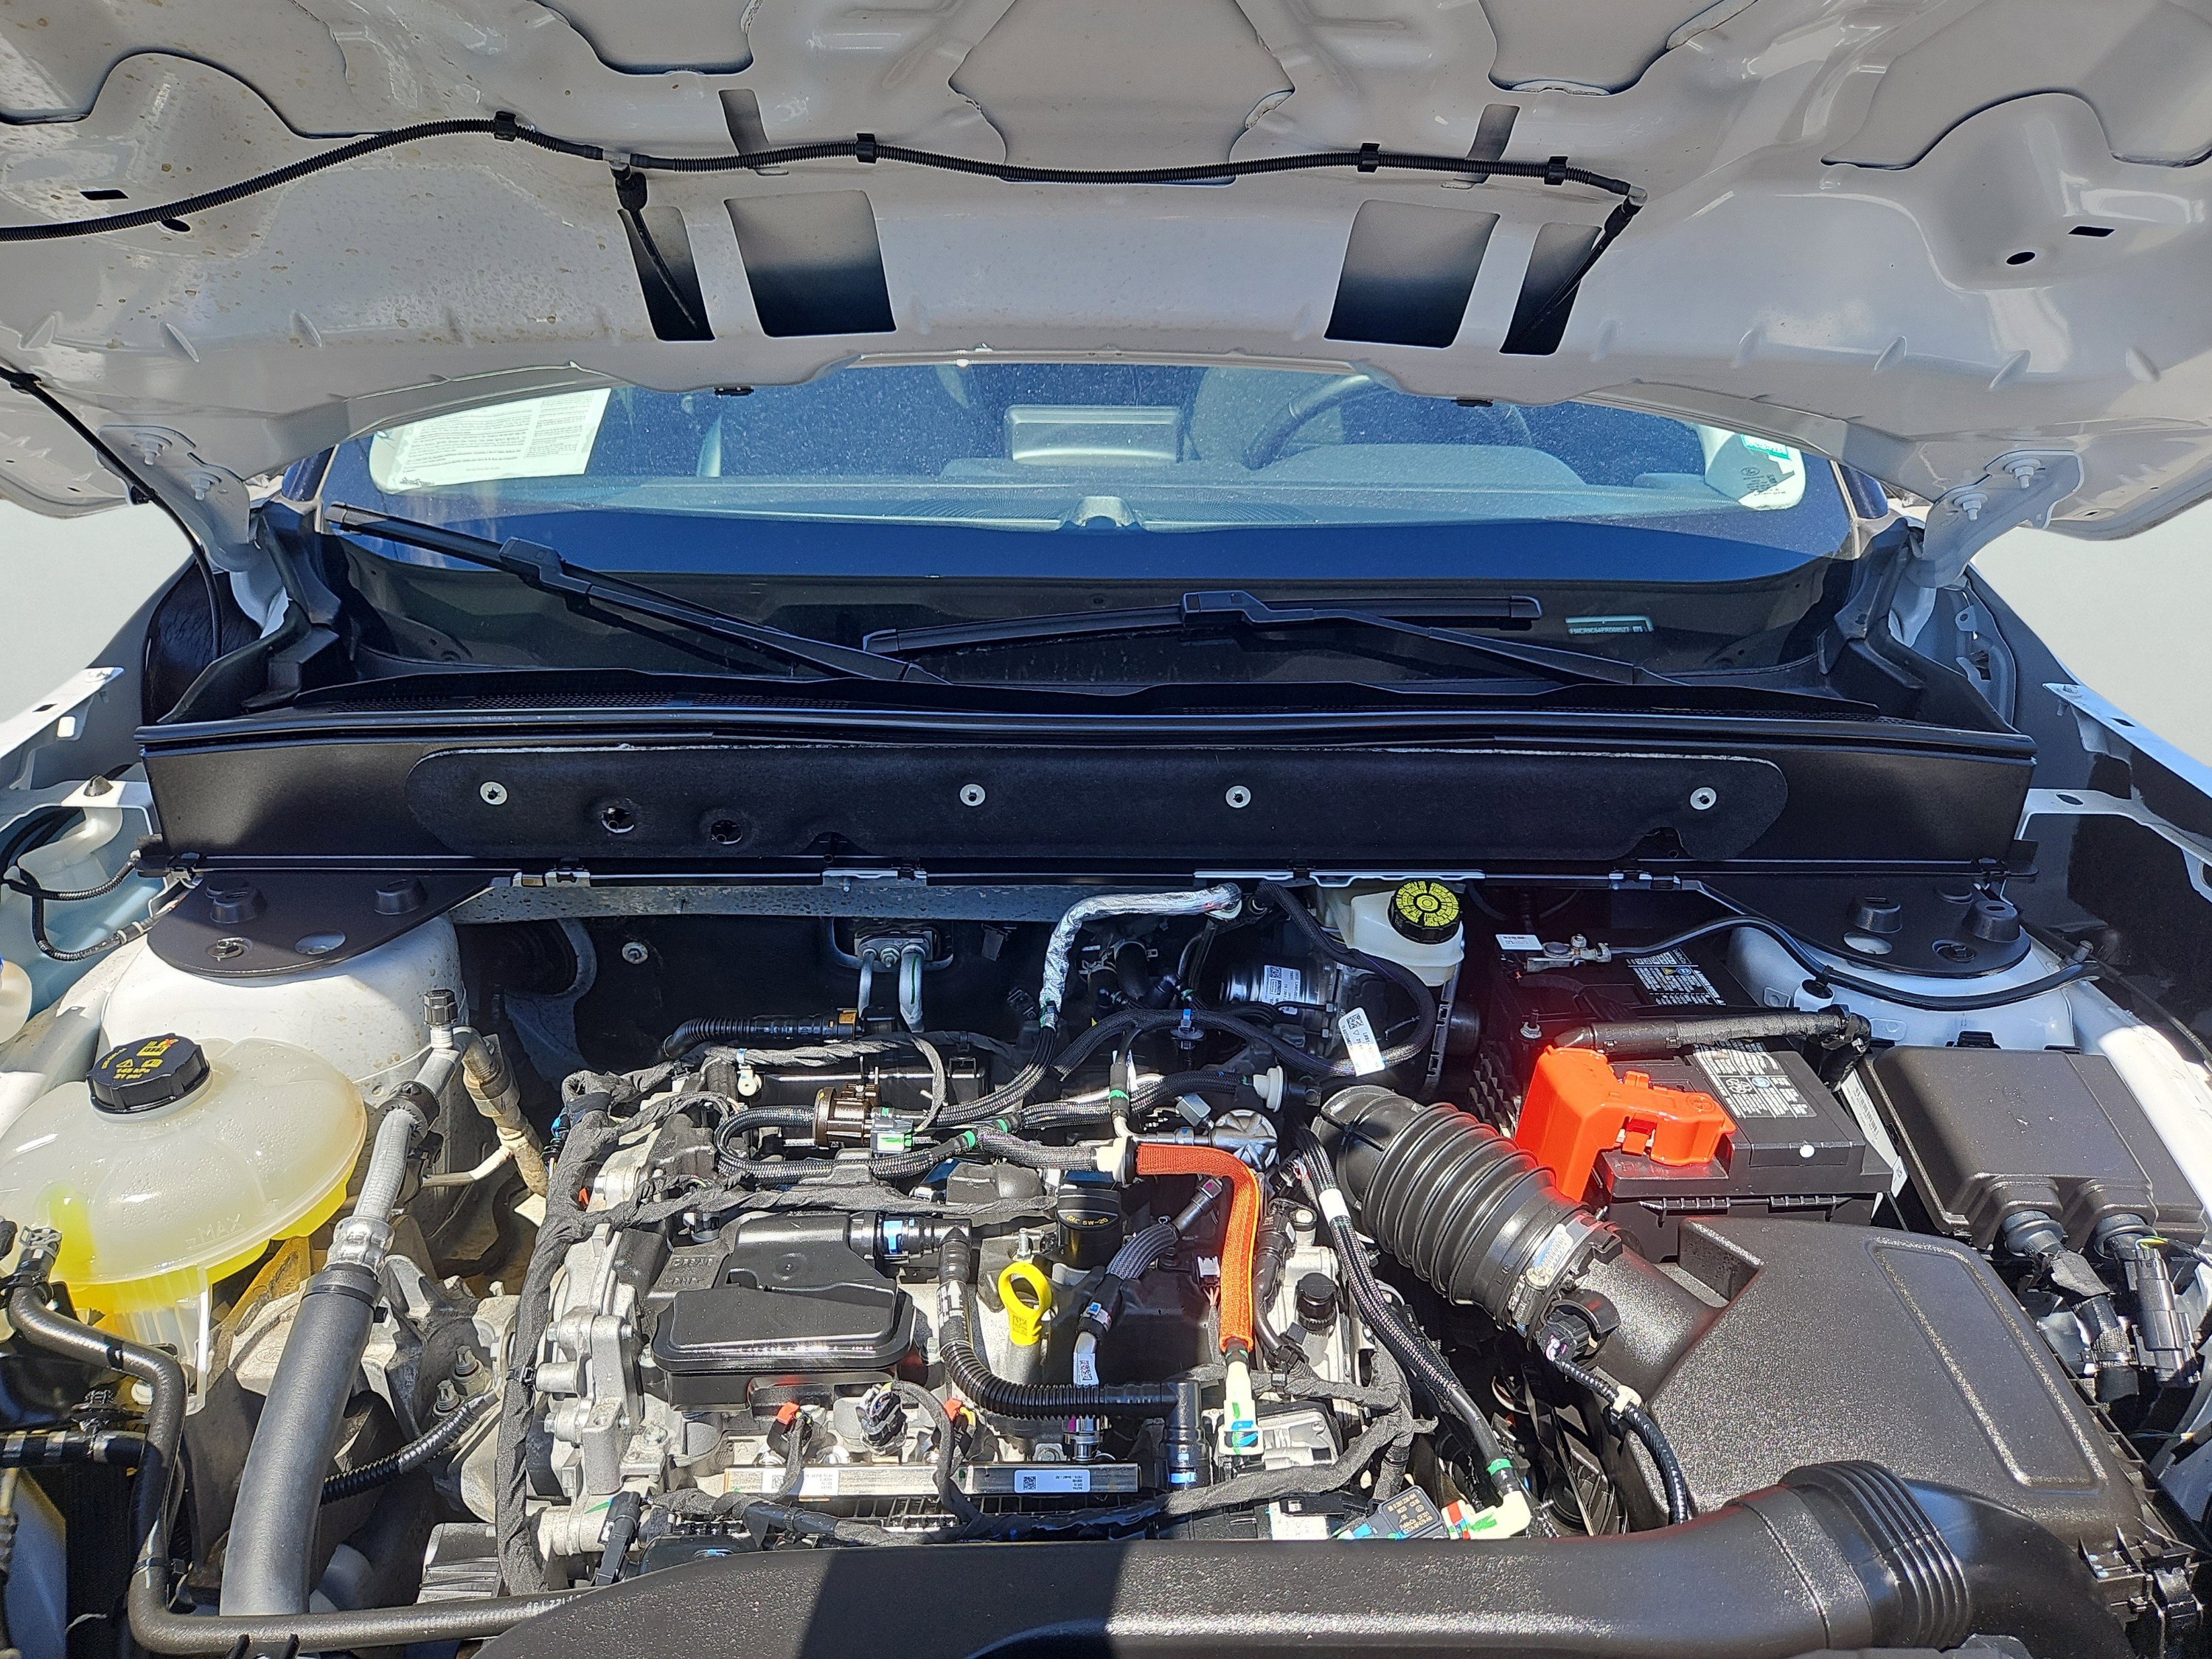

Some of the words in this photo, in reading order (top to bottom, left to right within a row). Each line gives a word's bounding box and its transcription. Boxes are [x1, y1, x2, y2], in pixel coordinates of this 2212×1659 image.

[198, 1213, 244, 1243] MAX
[1066, 1215, 1081, 1224] SAE
[1082, 1217, 1109, 1225] 5W-20
